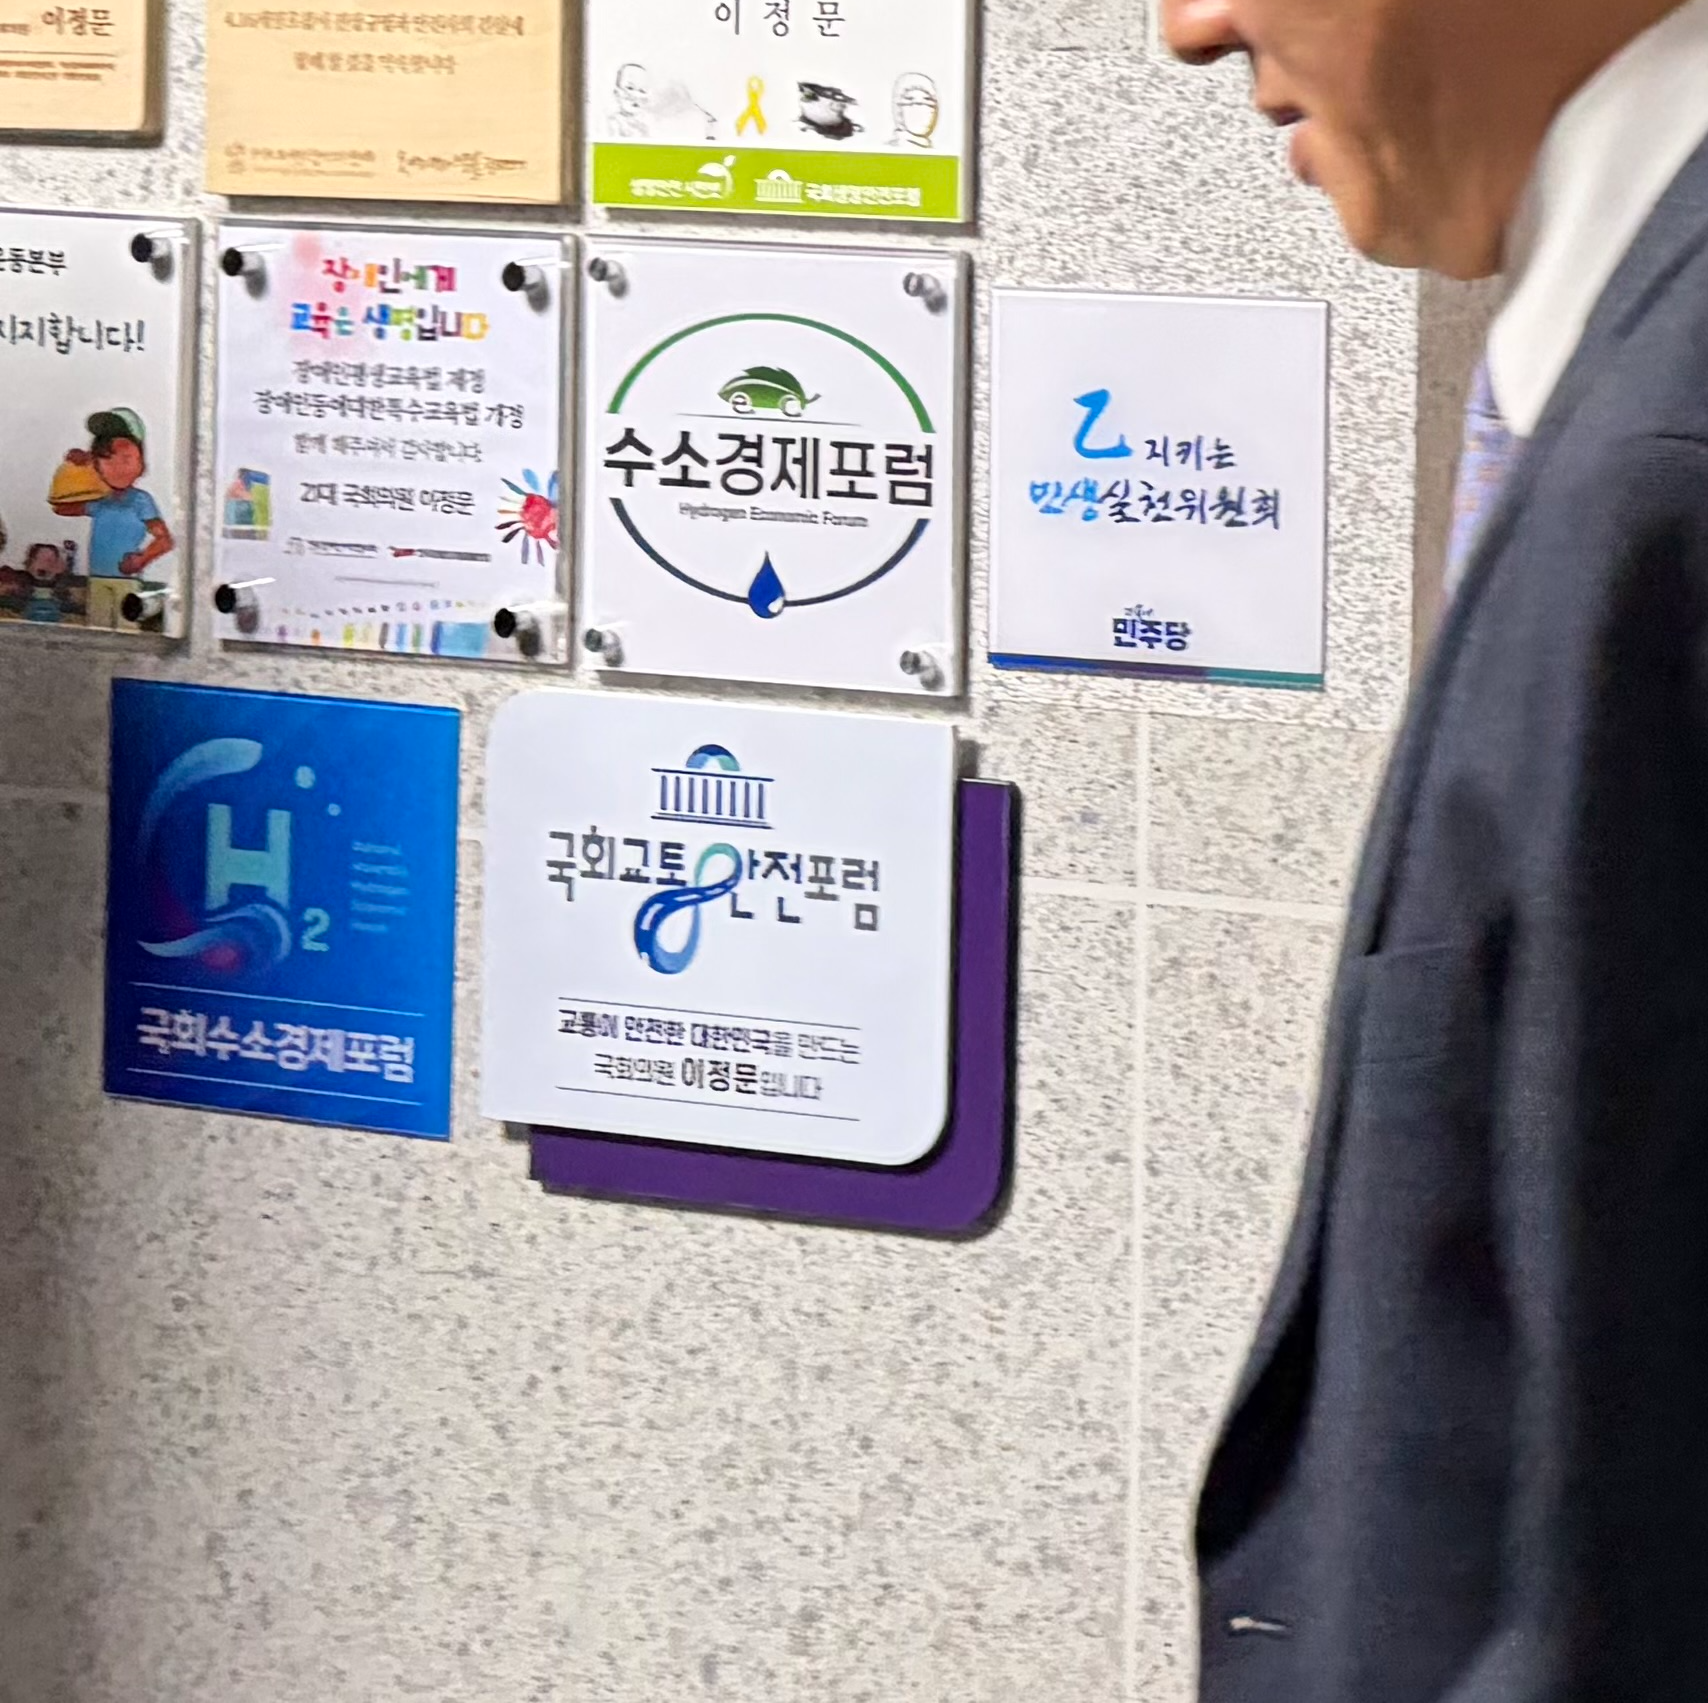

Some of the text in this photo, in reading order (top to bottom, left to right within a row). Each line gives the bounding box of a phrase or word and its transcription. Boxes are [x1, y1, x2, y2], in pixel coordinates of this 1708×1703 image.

[41, 6, 115, 36] 이정문
[0, 247, 67, 276] 동본부
[291, 302, 490, 341] 교육은 생명입니다
[603, 427, 934, 507] 수소경제포럼
[1143, 435, 1238, 470] 지키는
[1028, 477, 1281, 530] 민생실천위원회
[1112, 617, 1192, 651] 민주당
[137, 1006, 415, 1083] 국회수소경제포럼
[624, 1015, 686, 1045] 안전한
[691, 1022, 793, 1057] 대한민국을
[798, 1034, 860, 1064] 만드는
[594, 1053, 676, 1086] 국회의원
